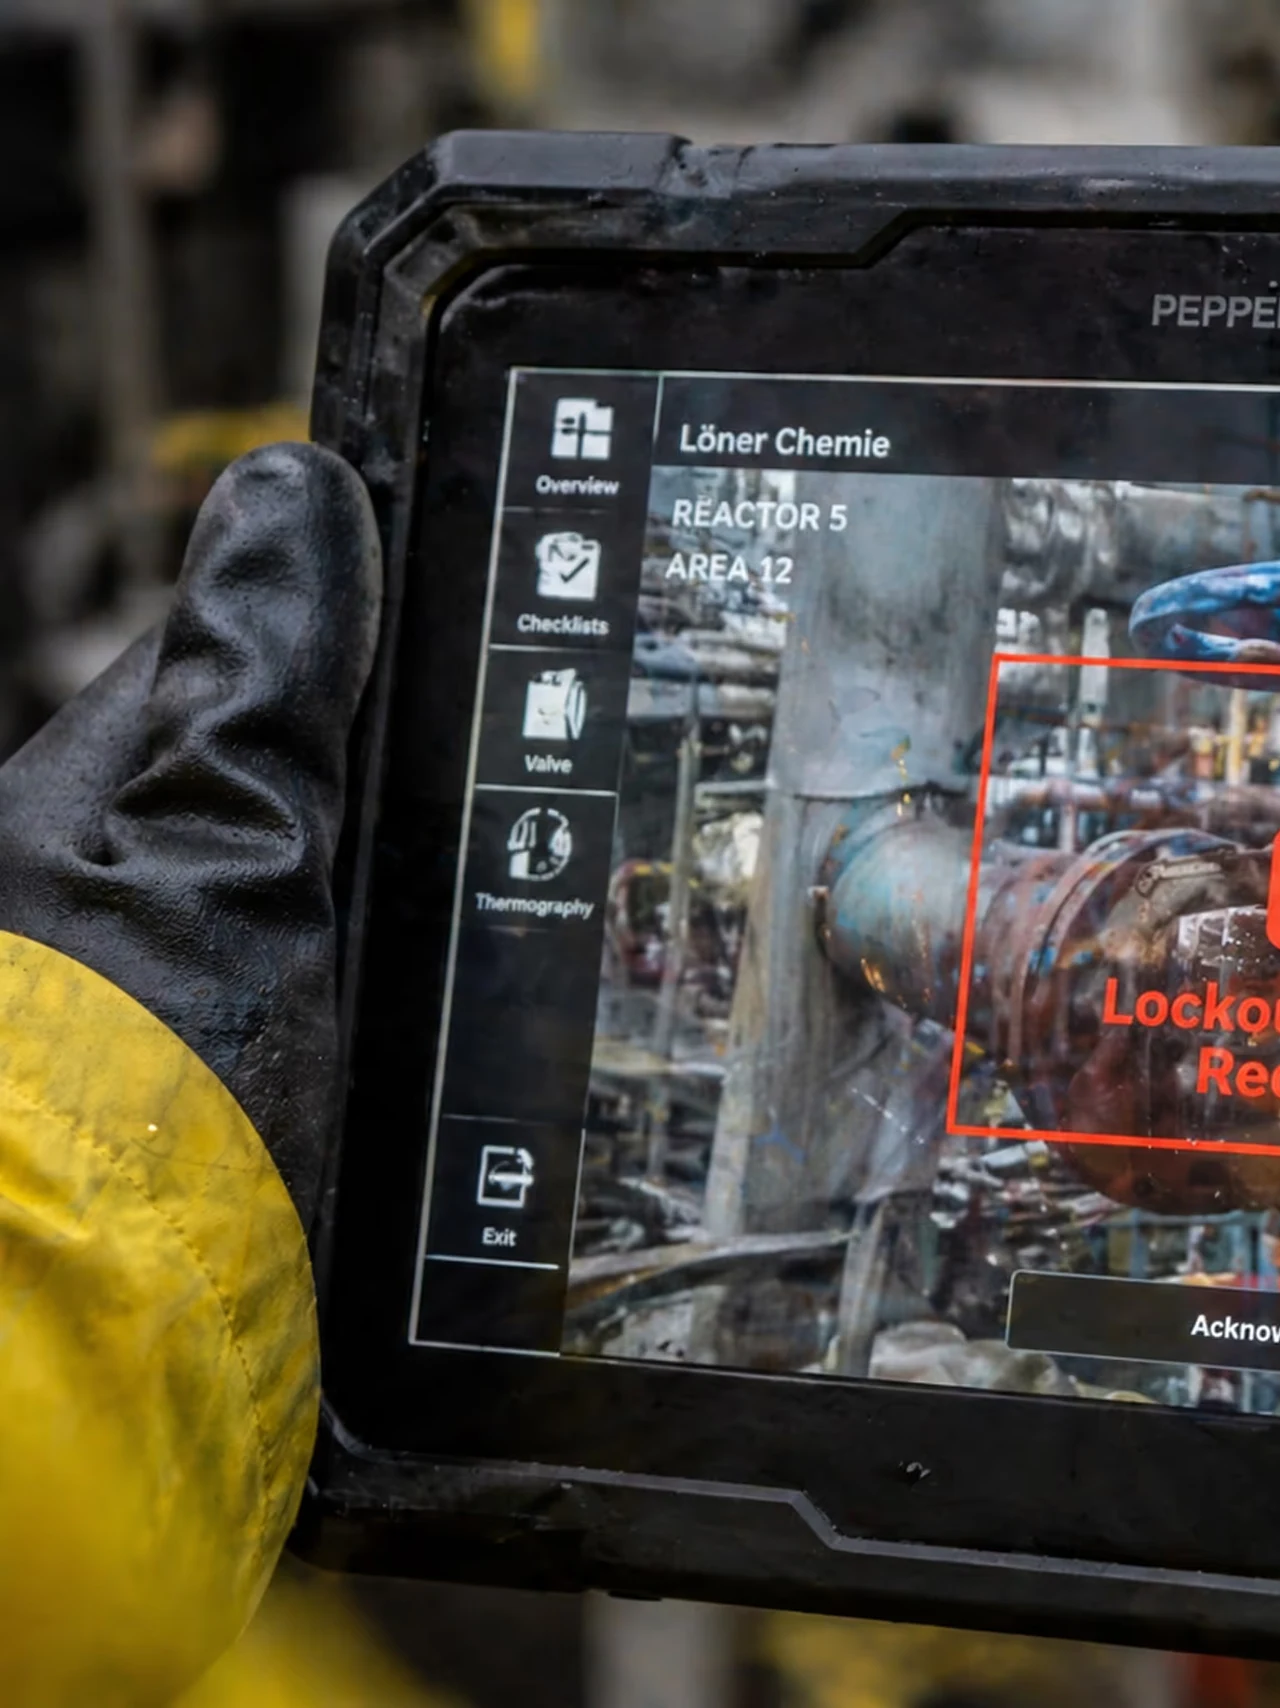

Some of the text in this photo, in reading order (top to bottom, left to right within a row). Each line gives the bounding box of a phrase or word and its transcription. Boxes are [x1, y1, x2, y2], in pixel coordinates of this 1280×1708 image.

[679, 424, 891, 458] Löner Chemie
[535, 474, 620, 496] Overview
[672, 500, 848, 532] REACTOR 5
[664, 553, 793, 584] AREA 12
[516, 613, 610, 636] Checklists
[524, 754, 573, 774] Valve
[475, 892, 595, 920] Thermography
[482, 1227, 517, 1248] Exit
